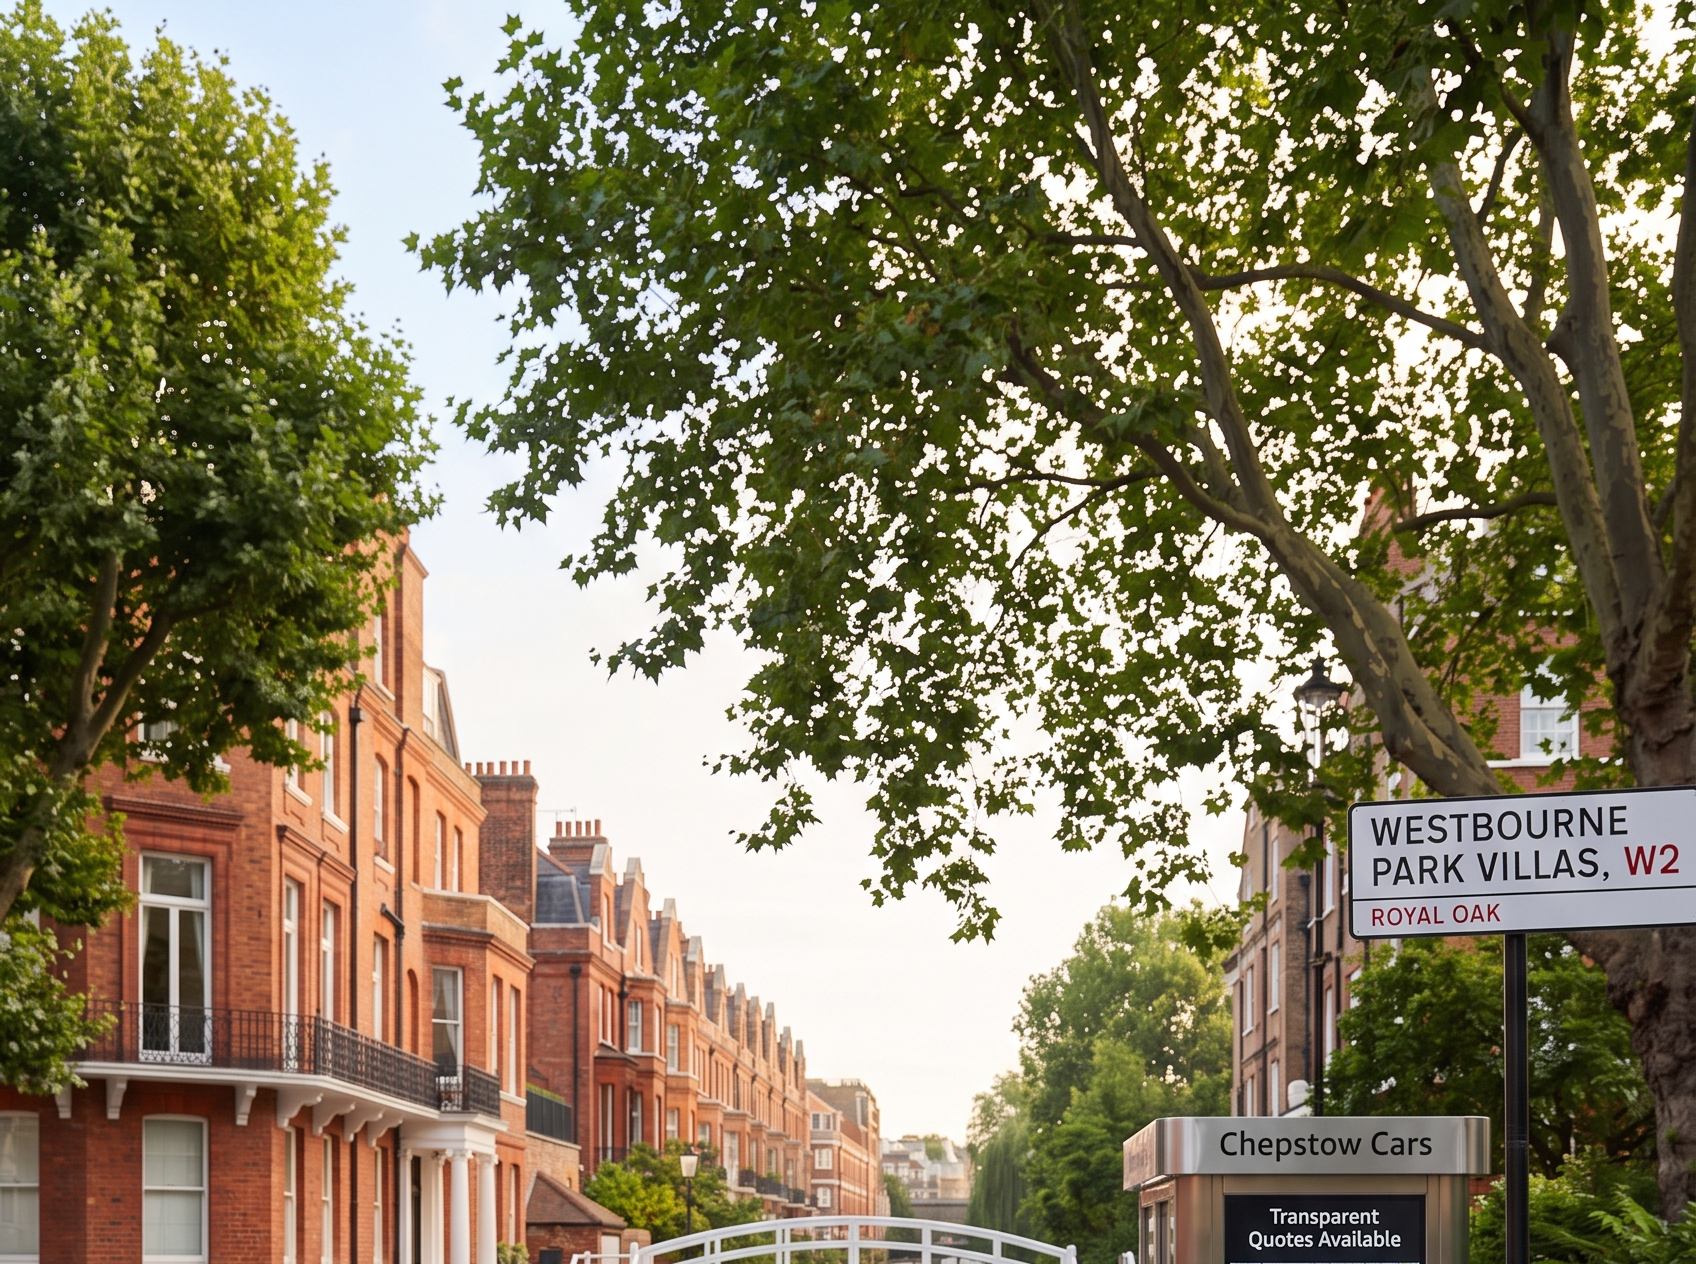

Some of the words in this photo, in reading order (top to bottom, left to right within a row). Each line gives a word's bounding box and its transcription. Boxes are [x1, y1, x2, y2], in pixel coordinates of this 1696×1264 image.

[1371, 805, 1629, 847] WESTBOURNE
[1372, 853, 1465, 887] PARK
[1477, 847, 1610, 882] VILLAS,
[1624, 844, 1680, 876] W2
[1371, 906, 1445, 927] ROYAL
[1452, 903, 1501, 924] OAK
[1219, 1131, 1362, 1162] Chepstow
[1370, 1131, 1433, 1157] Cars
[1269, 1208, 1380, 1229] Transparent
[1248, 1230, 1314, 1250] Quotes
[1317, 1230, 1402, 1248] Available
